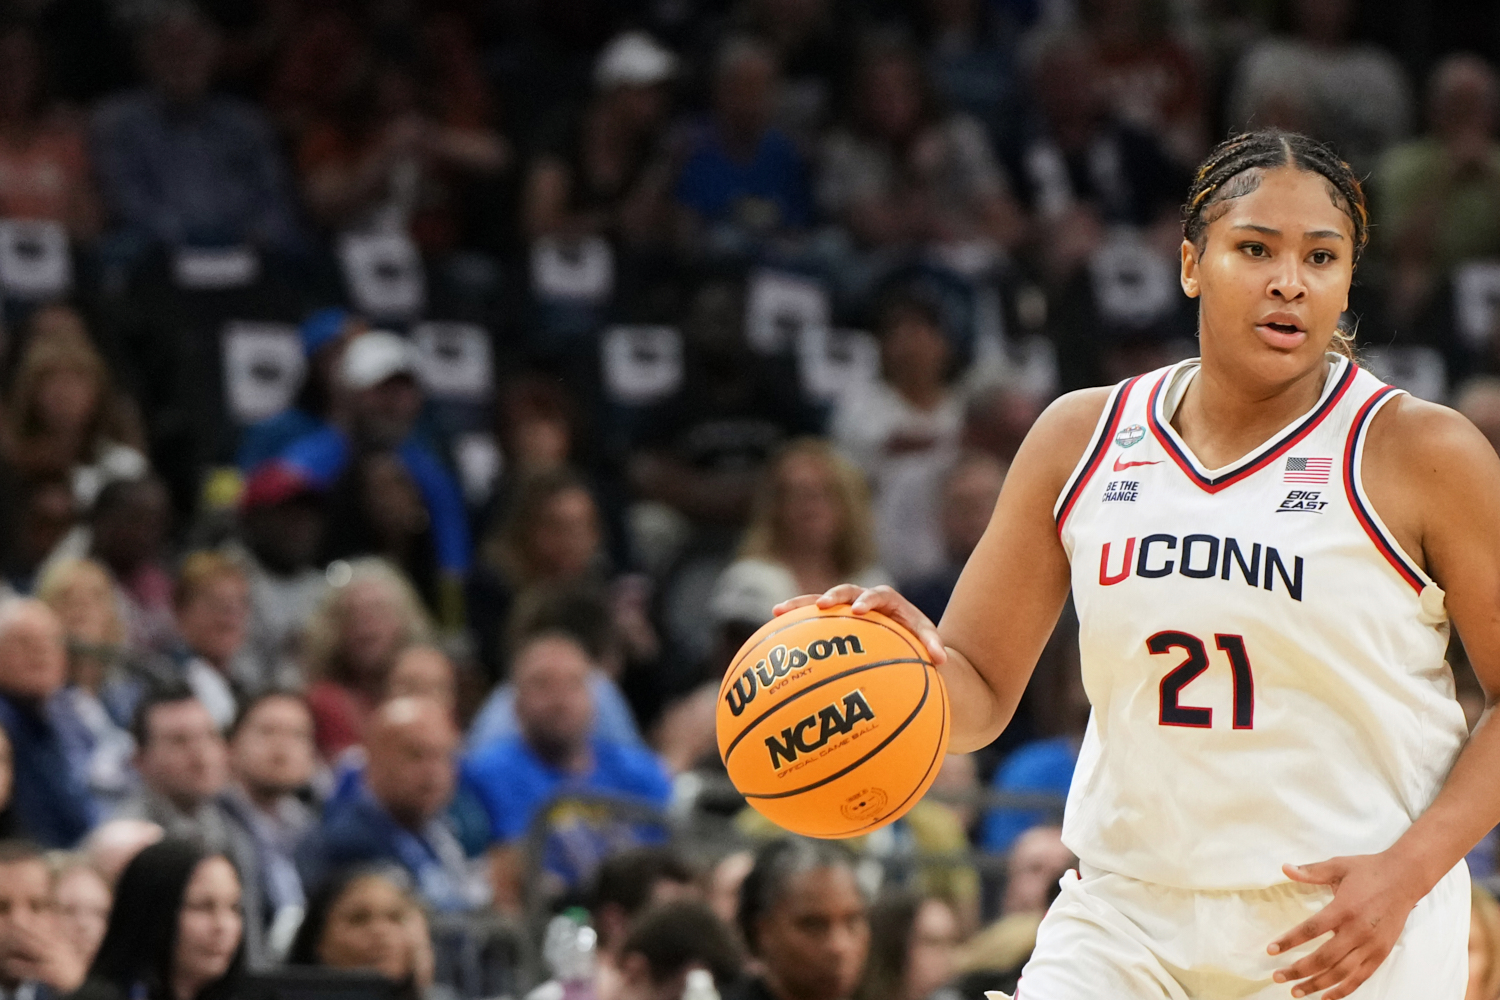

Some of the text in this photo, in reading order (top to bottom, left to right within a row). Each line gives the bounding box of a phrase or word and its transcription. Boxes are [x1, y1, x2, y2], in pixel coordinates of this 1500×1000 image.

[1102, 491, 1138, 502] CHANGE
[1106, 481, 1139, 491] BE THE
[1279, 500, 1329, 510] EAST
[1286, 490, 1321, 500] BIG
[1098, 533, 1304, 602] UCONN
[725, 634, 865, 717] Wilson
[769, 667, 813, 695] EVO NXT
[1146, 630, 1254, 730] 21
[764, 688, 876, 772] NCAA
[777, 723, 879, 779] OFFICIAL GAME BALL
